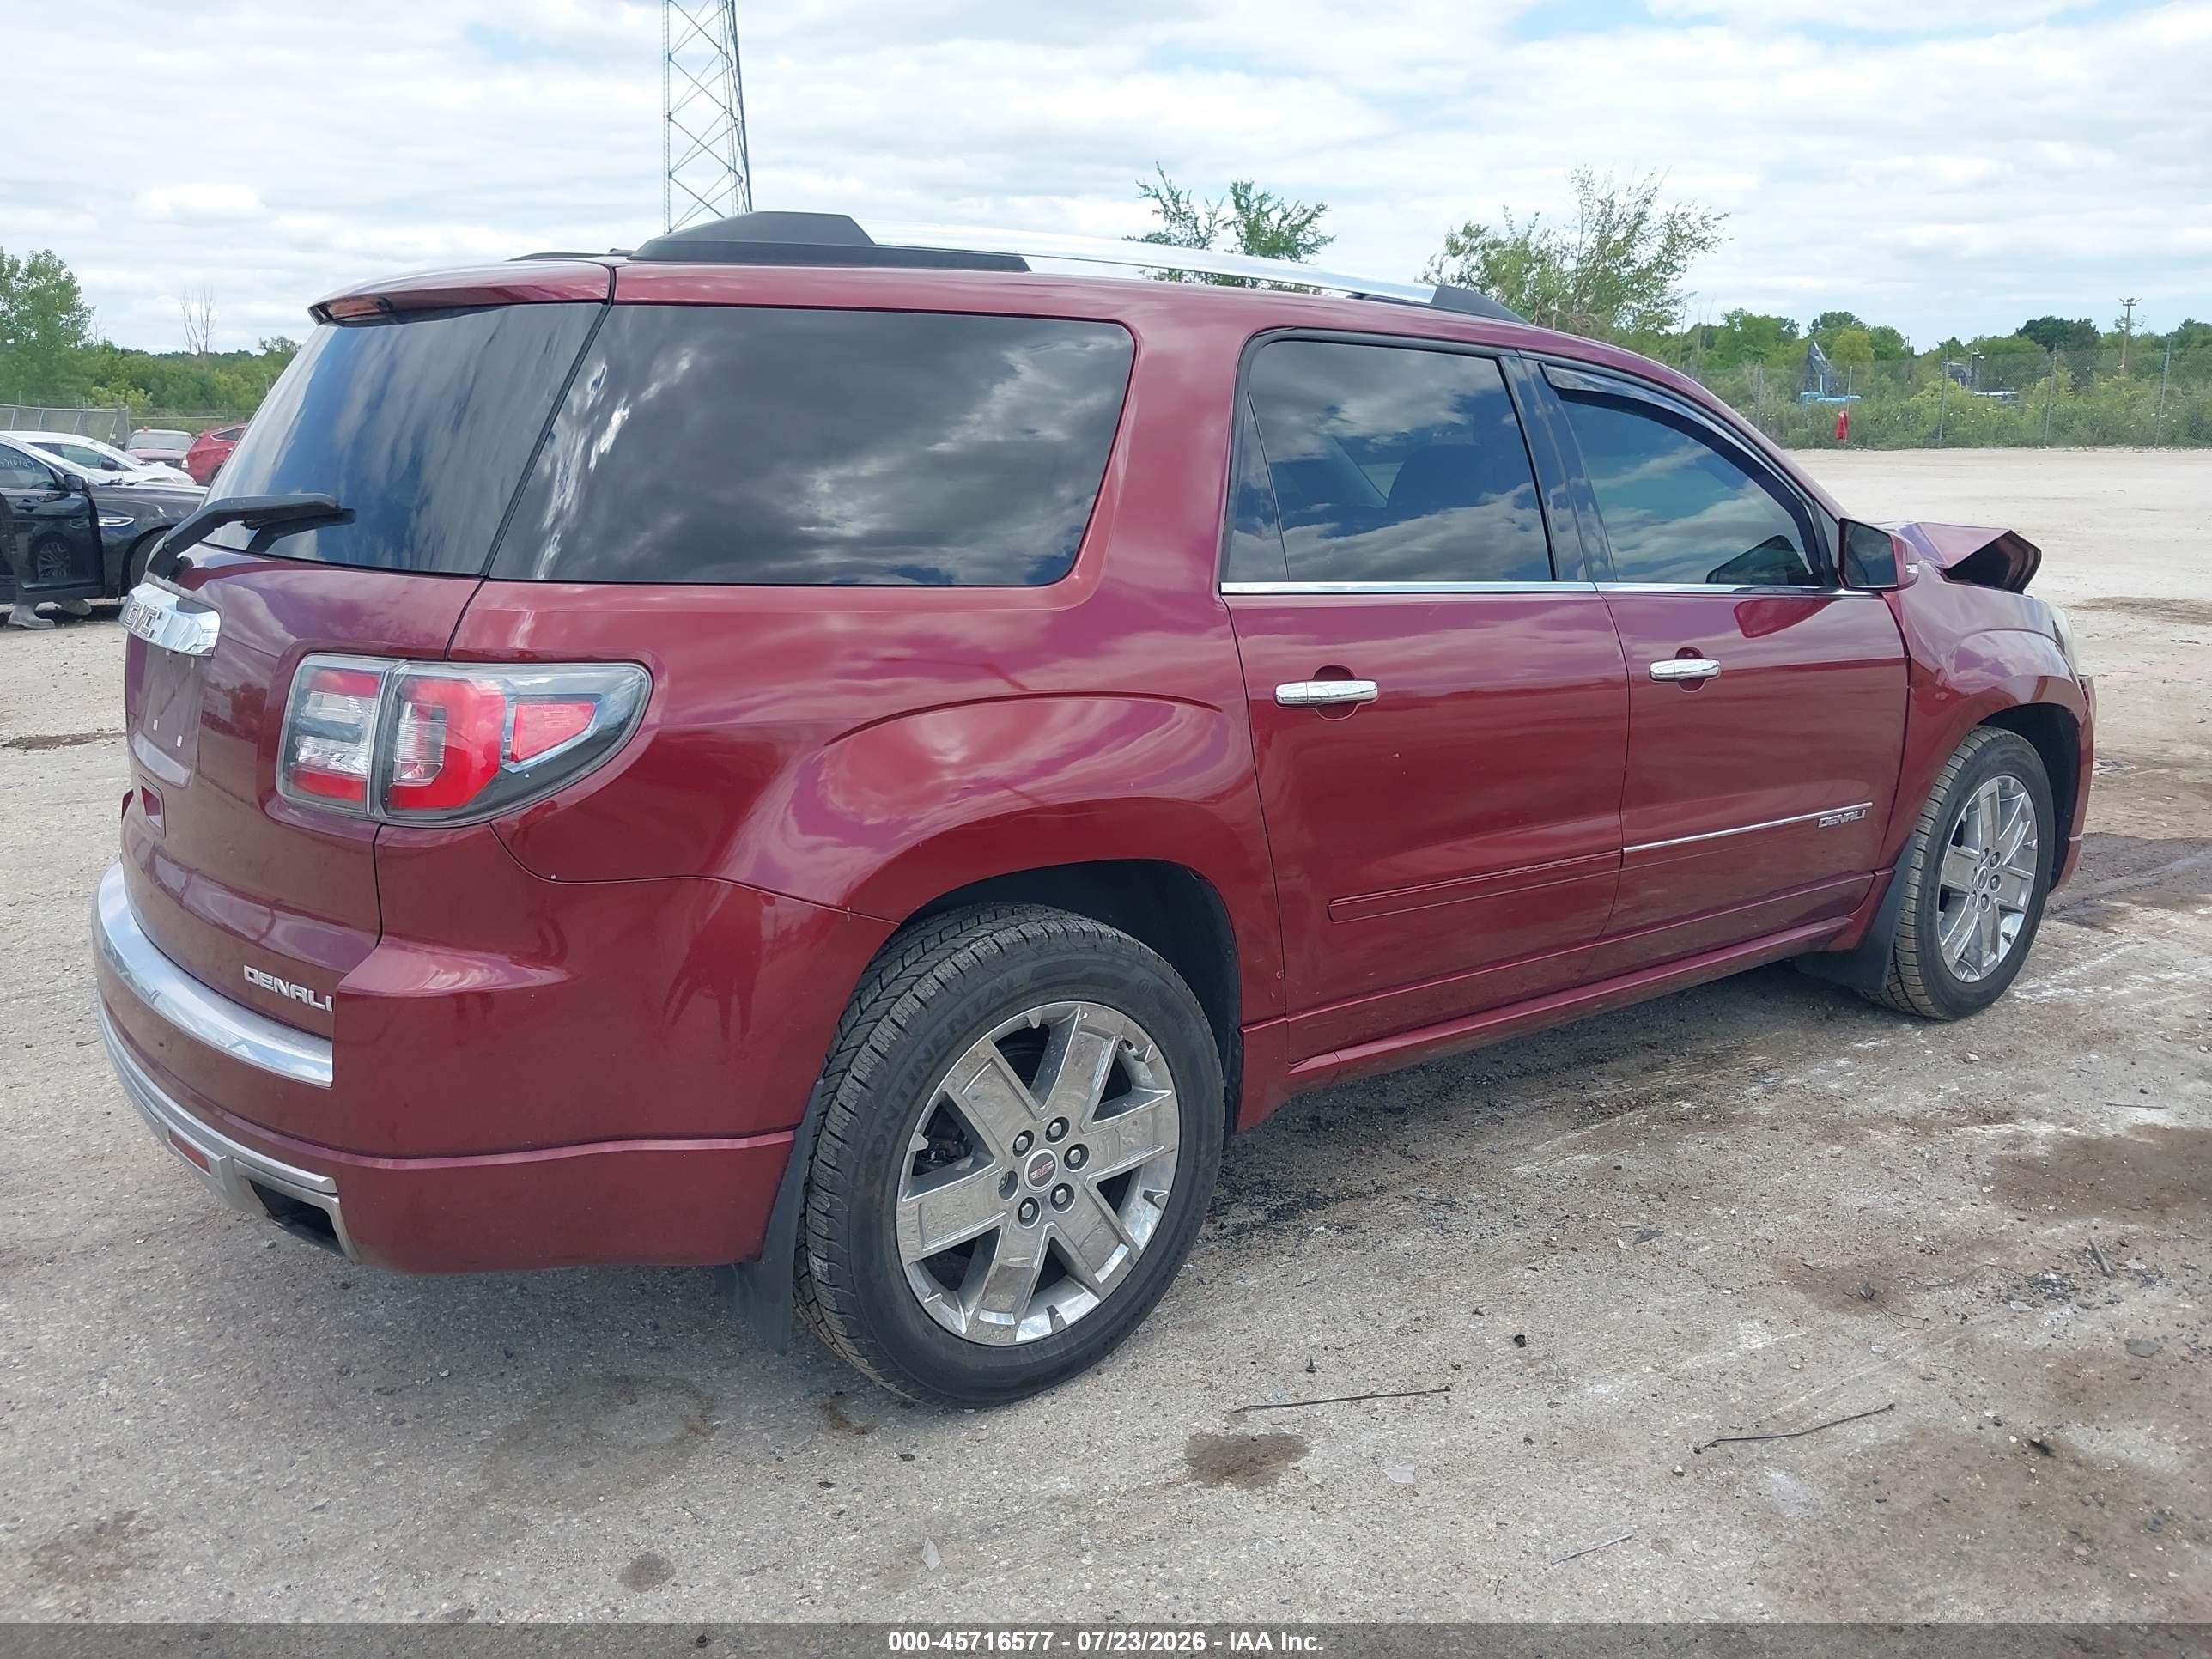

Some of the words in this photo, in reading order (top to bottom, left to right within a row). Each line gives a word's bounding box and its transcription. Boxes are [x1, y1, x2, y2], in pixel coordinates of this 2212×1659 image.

[124, 602, 163, 639] GMC
[1818, 809, 1868, 829] DENALI
[243, 964, 333, 1012] DENALI
